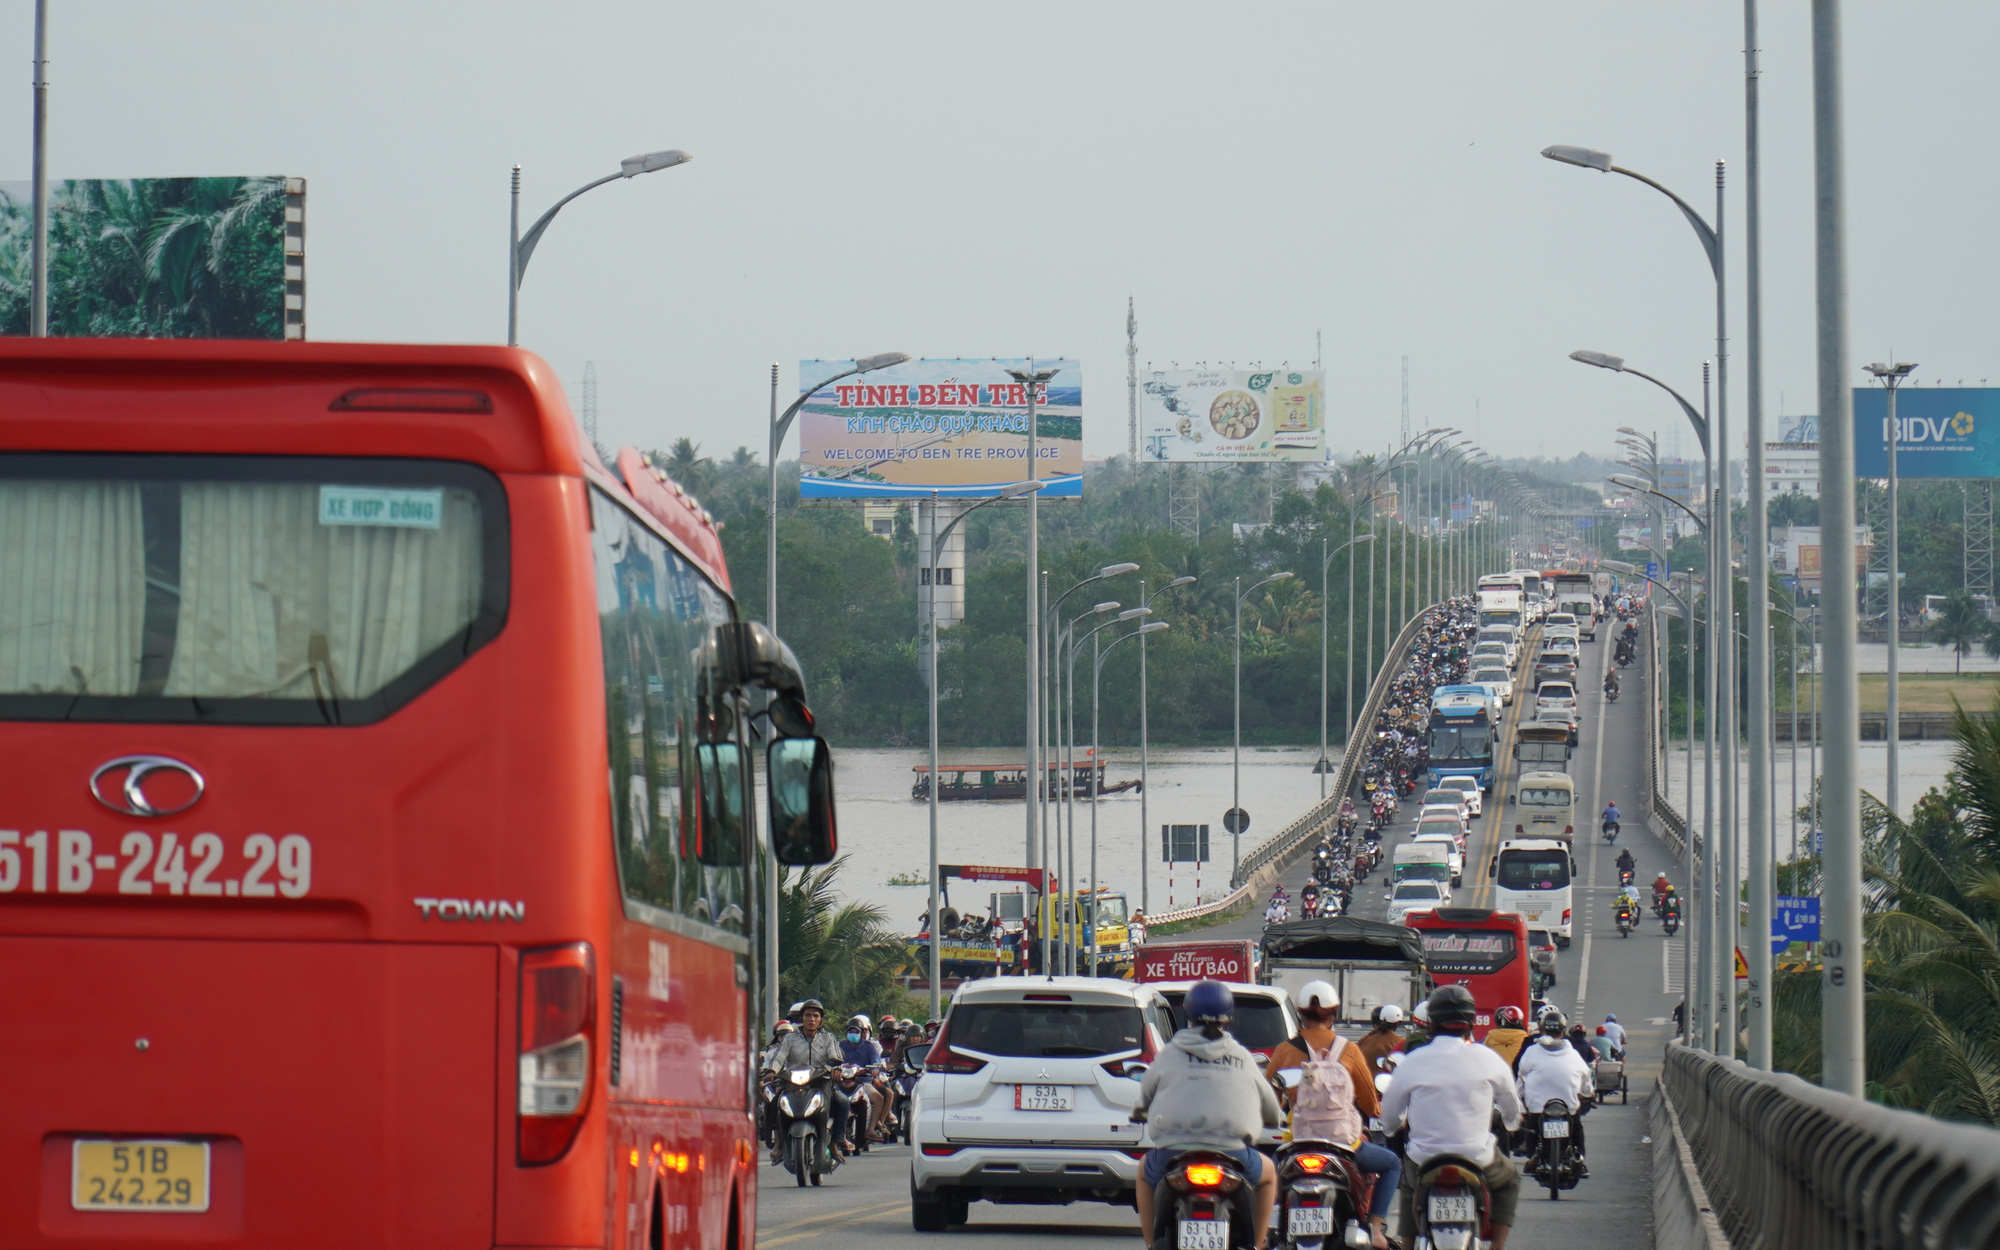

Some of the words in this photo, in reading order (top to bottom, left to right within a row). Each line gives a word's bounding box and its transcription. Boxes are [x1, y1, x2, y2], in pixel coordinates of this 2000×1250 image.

[835, 378, 909, 407] TỈNH
[917, 377, 980, 407] BẾN
[987, 383, 1048, 406] TRE
[846, 412, 884, 433] KÍNH
[889, 411, 936, 433] CHÀO
[940, 412, 974, 433] QUÝ
[1883, 417, 1950, 442] BIDV
[823, 448, 897, 460] WELCOME
[900, 449, 919, 460] TO
[922, 448, 951, 460] BEN
[955, 448, 983, 460] TRE
[328, 498, 346, 517] XE
[351, 499, 384, 520] HỢP
[0, 830, 311, 898] 51B-242.29
[413, 897, 525, 922] TOWN
[940, 940, 966, 949] OTLINE:
[1146, 963, 1165, 977] XE
[1169, 961, 1204, 977] THƯ
[1206, 958, 1238, 976] BÁO
[1035, 1086, 1057, 1097] 63A
[1027, 1098, 1066, 1109] 177.92
[113, 1147, 168, 1173] 51B
[90, 1177, 191, 1205] 242.29
[1295, 1209, 1324, 1220] 63-B4
[1436, 1209, 1467, 1219] 0973
[1186, 1222, 1219, 1235] 63-C1
[1291, 1221, 1328, 1233] 810.20
[1181, 1236, 1224, 1249] 324.69
